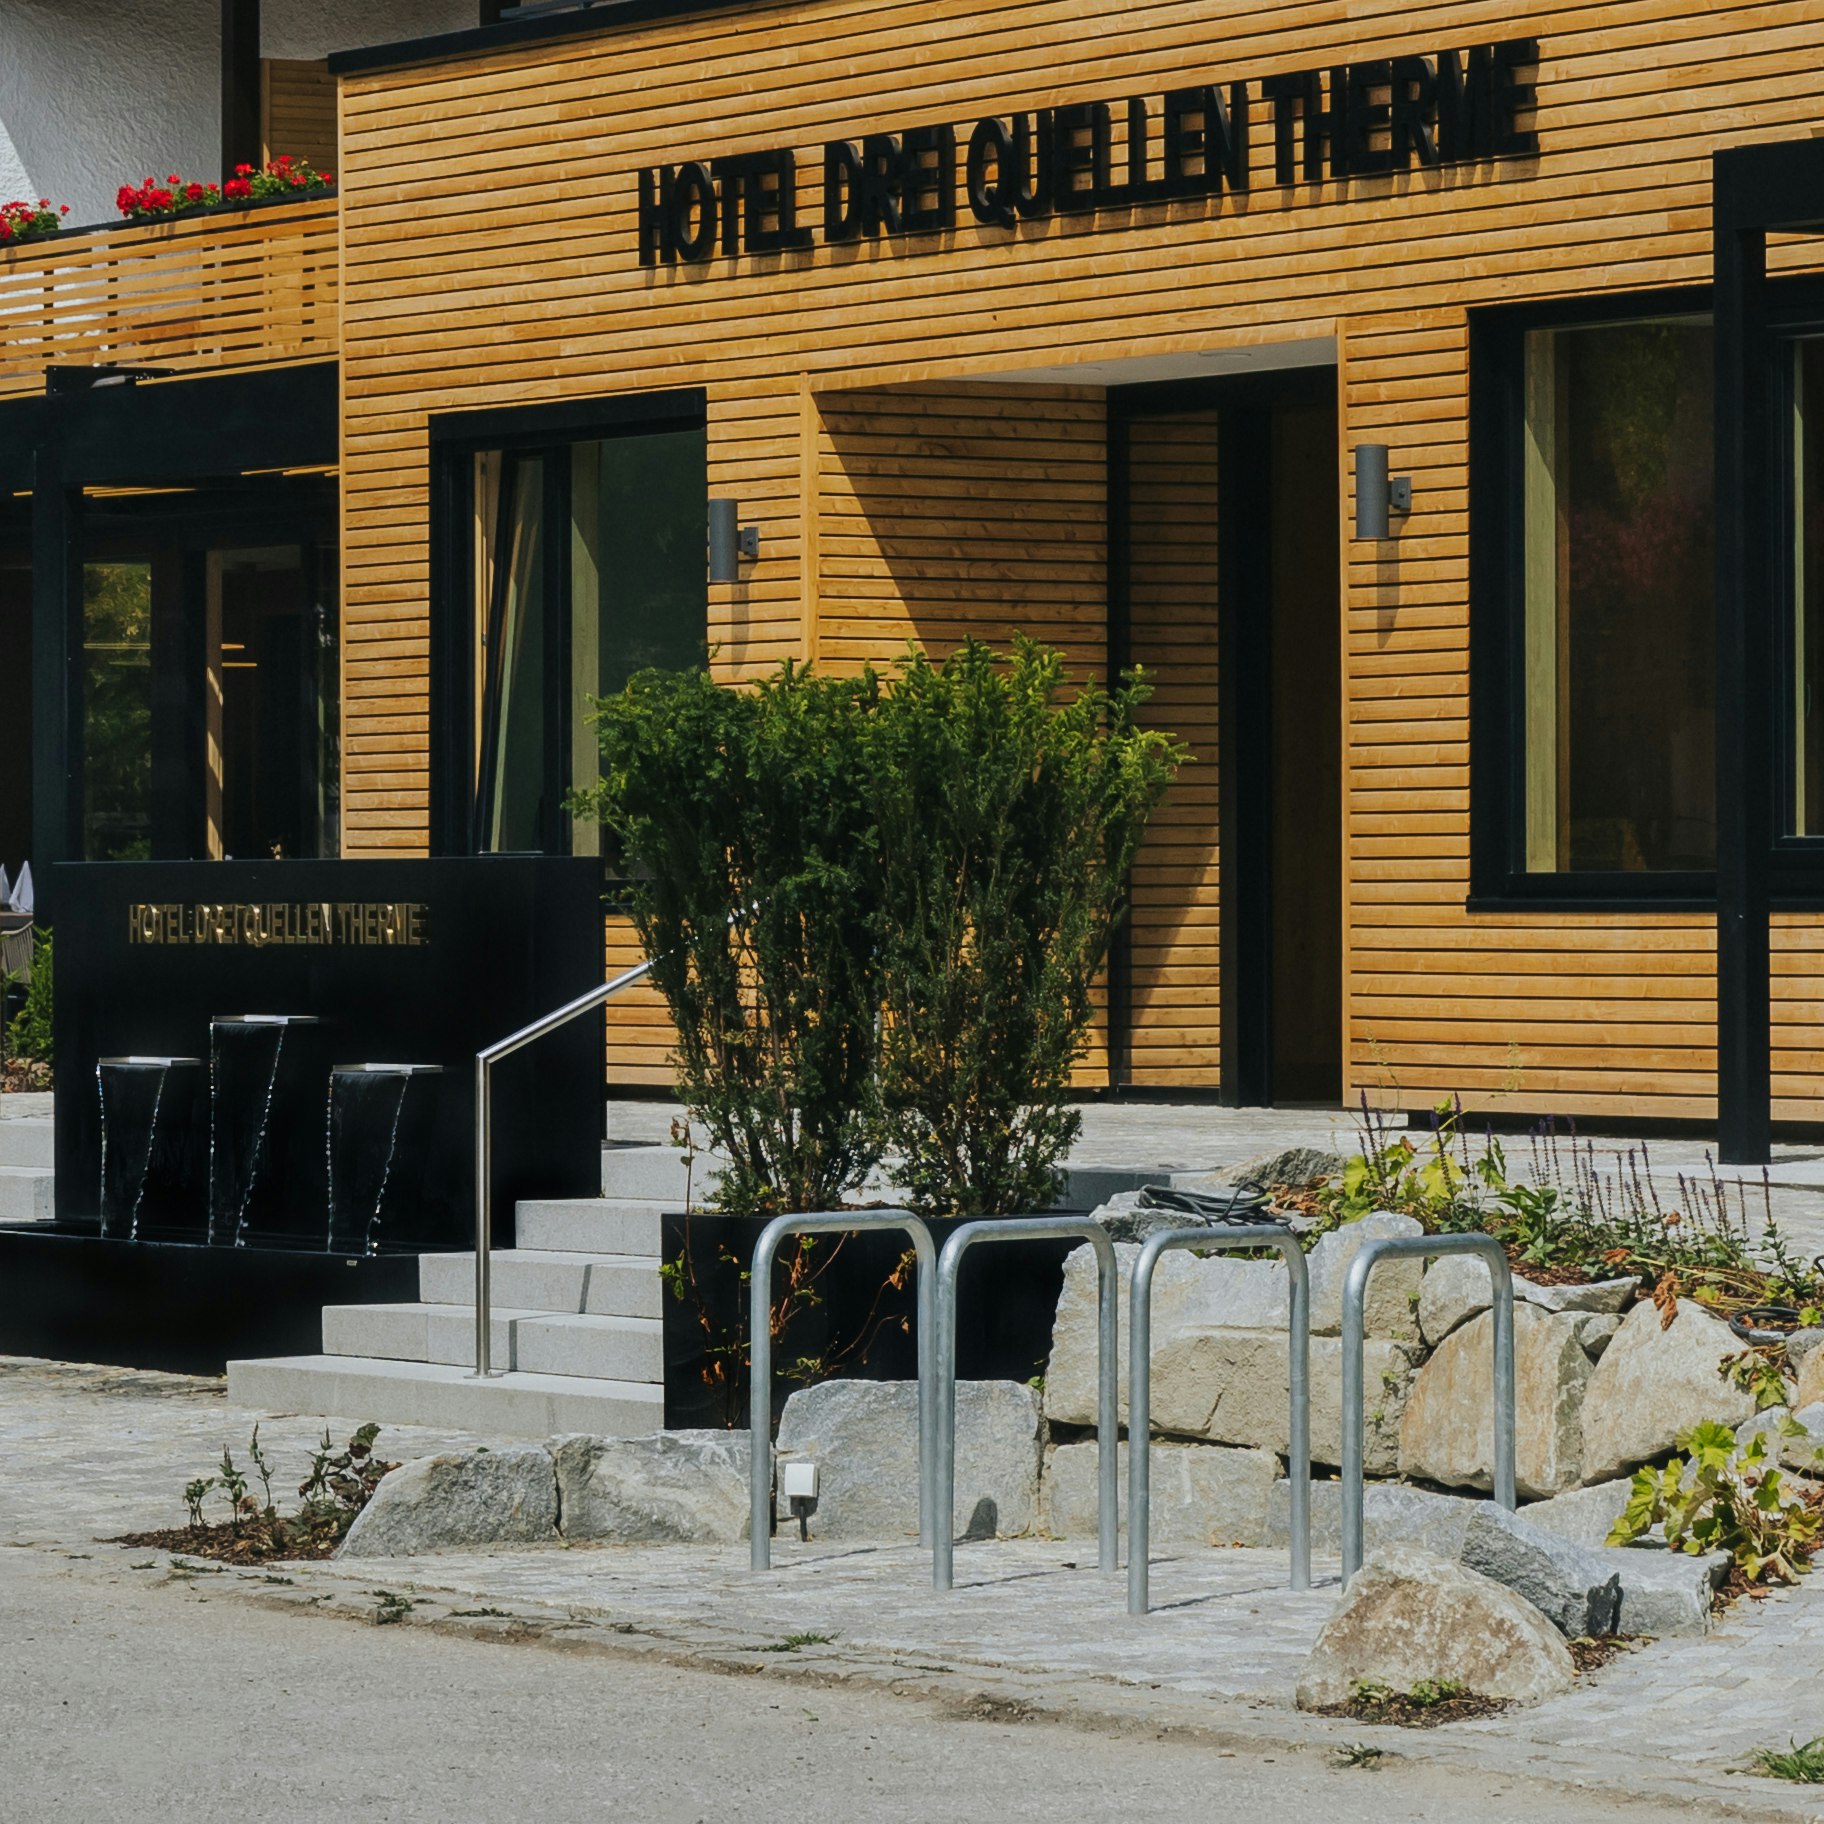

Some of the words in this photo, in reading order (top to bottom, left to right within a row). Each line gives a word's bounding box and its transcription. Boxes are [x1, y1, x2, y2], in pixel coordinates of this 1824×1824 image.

[638, 149, 814, 266] HOTEL
[824, 124, 956, 244] DREI
[966, 81, 1249, 230] QUELLEN
[1261, 37, 1540, 184] THERME
[129, 904, 189, 944] HOTEL
[195, 904, 239, 944] DREI
[243, 903, 332, 947] QUELLEN
